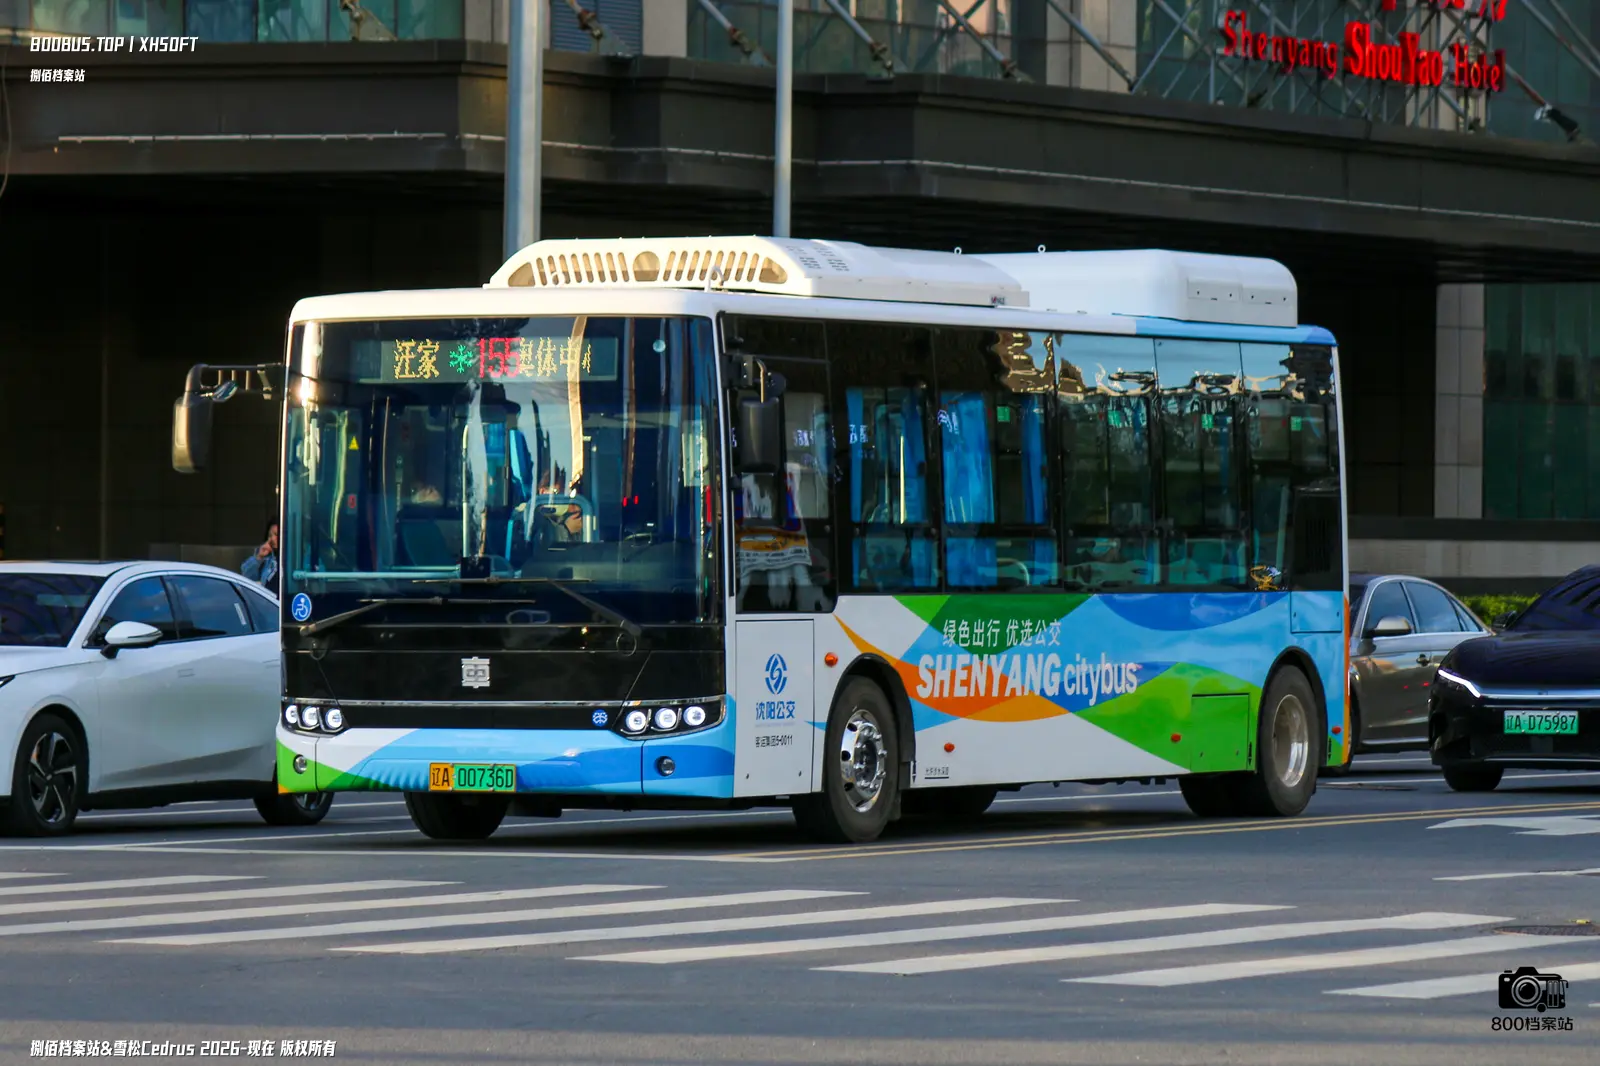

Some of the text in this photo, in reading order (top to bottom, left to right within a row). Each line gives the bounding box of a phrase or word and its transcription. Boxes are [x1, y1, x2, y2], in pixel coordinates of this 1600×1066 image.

[1222, 9, 1505, 91] Shenyang ShouYao Hotel
[394, 339, 440, 379] 汪家
[476, 337, 521, 379] 155
[942, 618, 1061, 648] 绿色出行 优选公交
[916, 653, 1138, 707] SHENYANG citybus
[755, 701, 796, 720] 沈阳公交
[1528, 714, 1576, 731] D75987
[457, 767, 514, 788] 00736D
